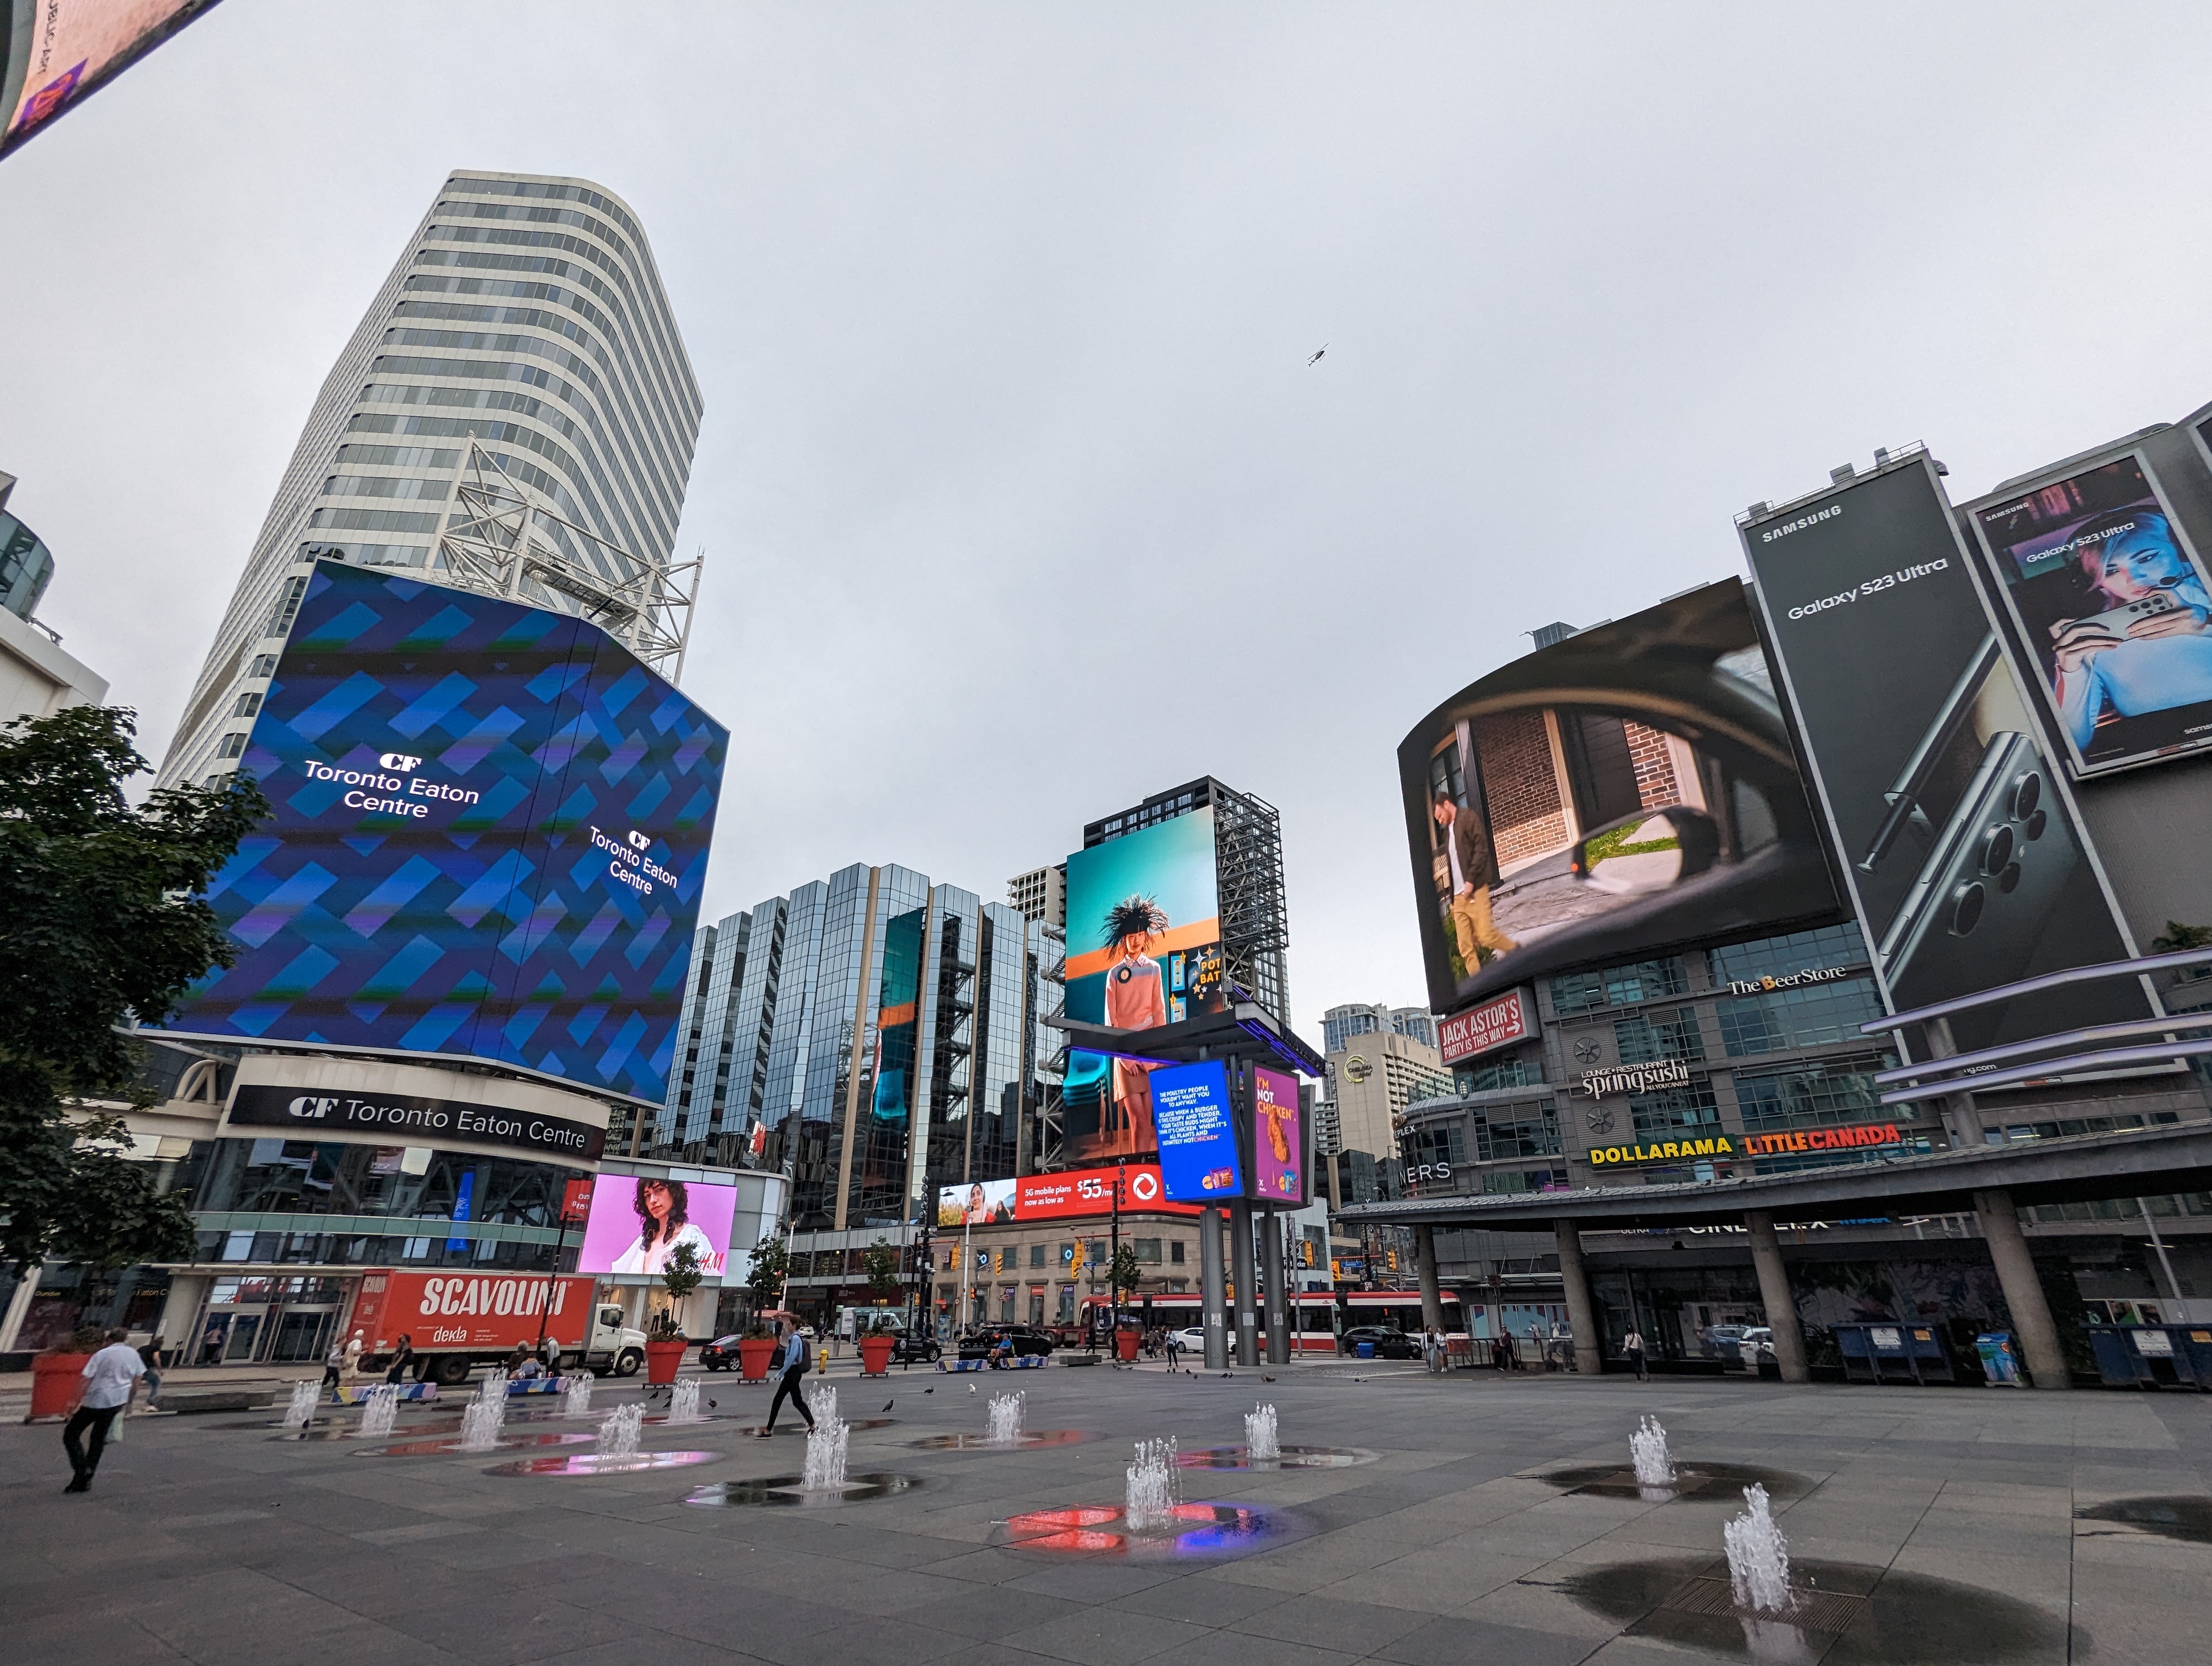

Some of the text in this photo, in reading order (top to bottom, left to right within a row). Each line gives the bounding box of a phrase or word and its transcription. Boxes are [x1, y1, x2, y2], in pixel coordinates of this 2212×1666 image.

[1762, 505, 1842, 543] SAMSUNG
[1985, 502, 2030, 522] SAMSUNG
[2026, 522, 2136, 563] Galaxy S23 Ultra
[1787, 558, 1949, 621] Galaxy S23 Ultra
[379, 753, 422, 772] CF
[305, 760, 479, 805] Toronto Eaton
[344, 790, 428, 818] Centre
[628, 830, 651, 851] CF
[590, 825, 678, 889] Toronto Eaton
[609, 861, 653, 895] Centre
[1200, 970, 1221, 984] BAT
[1201, 958, 1221, 972] POT
[1727, 966, 1848, 996] The Beer Store
[1442, 998, 1519, 1046] JACK ASTOR'S
[1444, 1041, 1464, 1059] PARTY
[1465, 1038, 1472, 1052] IS
[1472, 1032, 1489, 1048] THIS
[1489, 1025, 1505, 1042] WAY
[1581, 1060, 1668, 1079] LOUNGE RESTAURANT
[1188, 1085, 1208, 1093] PEOPLE
[1257, 1076, 1269, 1091] I'M
[1257, 1088, 1274, 1104] NOT
[1195, 1105, 1218, 1113] BURGER
[1199, 1116, 1218, 1124] MIGHT
[288, 1096, 586, 1149] CF Toronto Eaton Centre
[1590, 1137, 1733, 1165] DOLLARAMA
[1744, 1124, 1901, 1156] LITTLE CANADA
[1399, 1162, 1451, 1186] NERS
[1024, 1199, 1038, 1207] now
[1045, 1196, 1056, 1204] low
[1025, 1188, 1034, 1197] 5G
[1034, 1186, 1054, 1196] mobile
[1055, 1184, 1072, 1195] plans
[420, 1277, 567, 1316] SCAVOLINI
